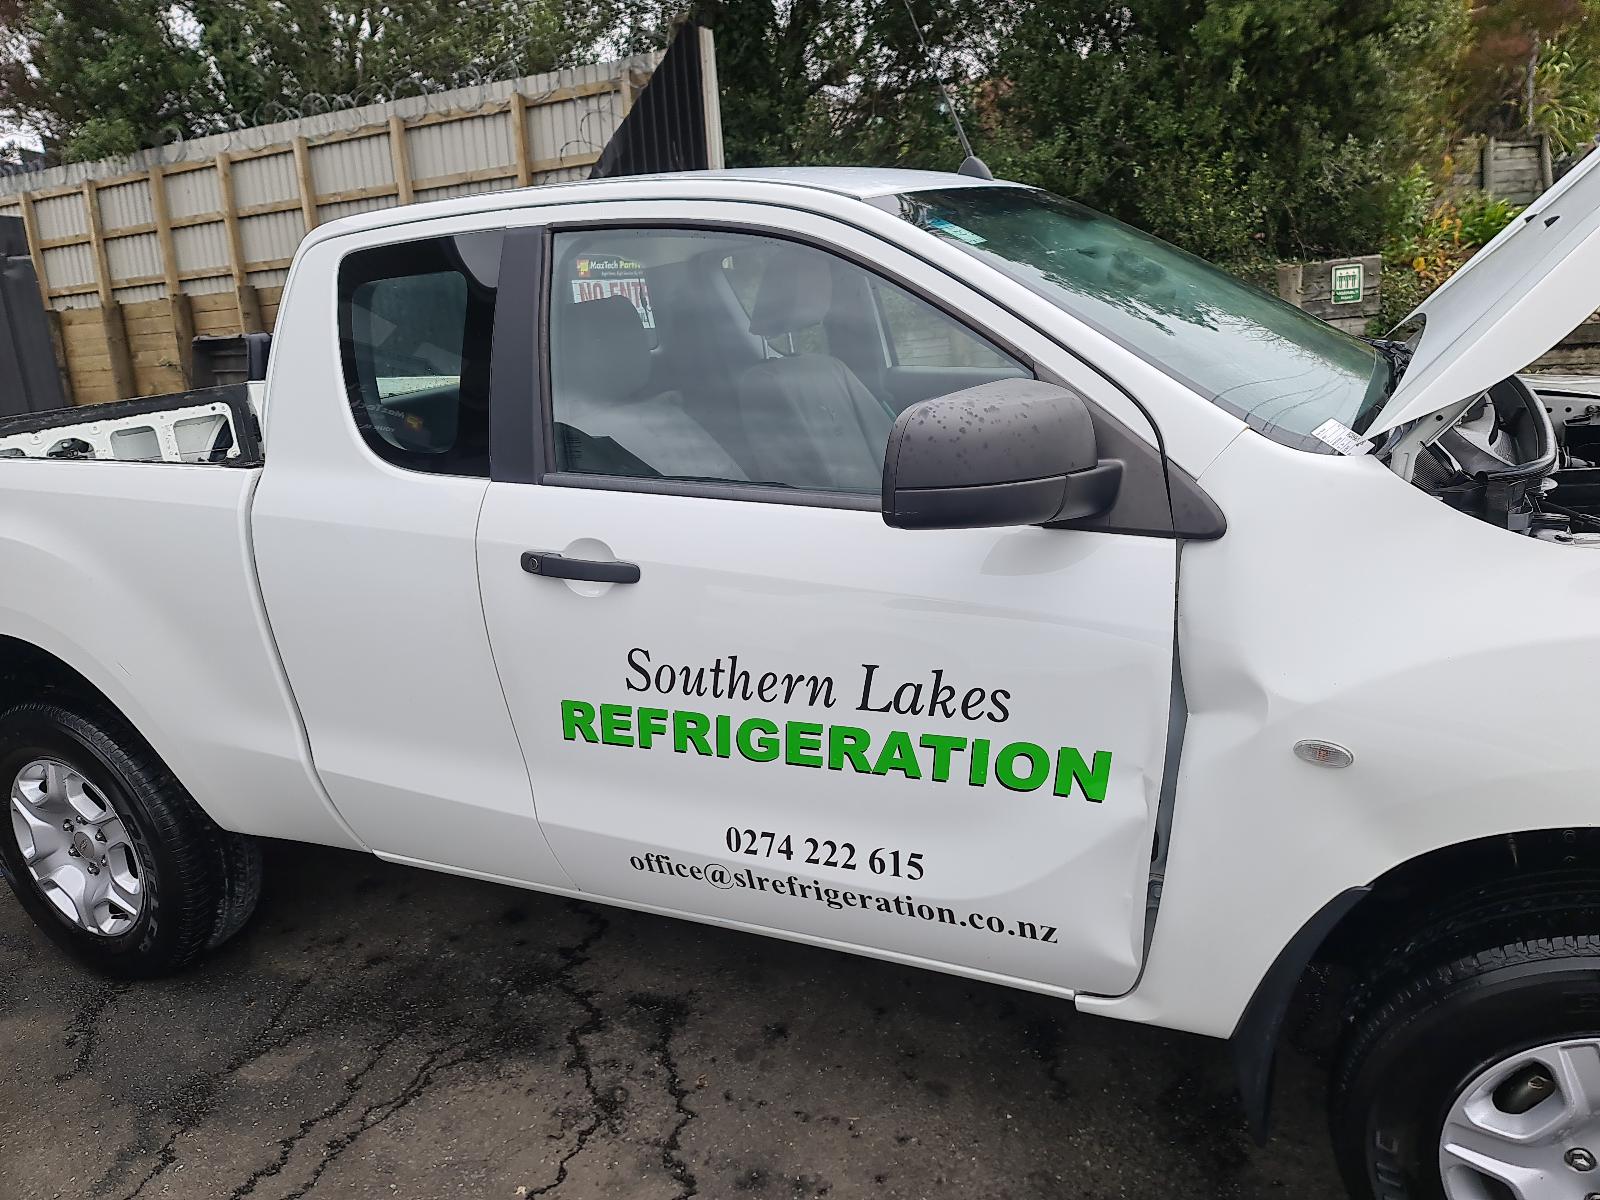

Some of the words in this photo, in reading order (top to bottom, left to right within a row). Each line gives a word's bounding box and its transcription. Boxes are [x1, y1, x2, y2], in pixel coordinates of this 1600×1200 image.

[579, 281, 604, 302] NO
[590, 260, 618, 269] MaxTech
[626, 648, 837, 709] Southern
[855, 663, 1011, 723] Lakes
[561, 699, 1113, 803] REFRIGERATION
[726, 826, 794, 861] 0274
[804, 837, 857, 870] 222
[868, 847, 924, 881] 615
[629, 852, 1058, 944] office@slrefrigeration.co.nz
